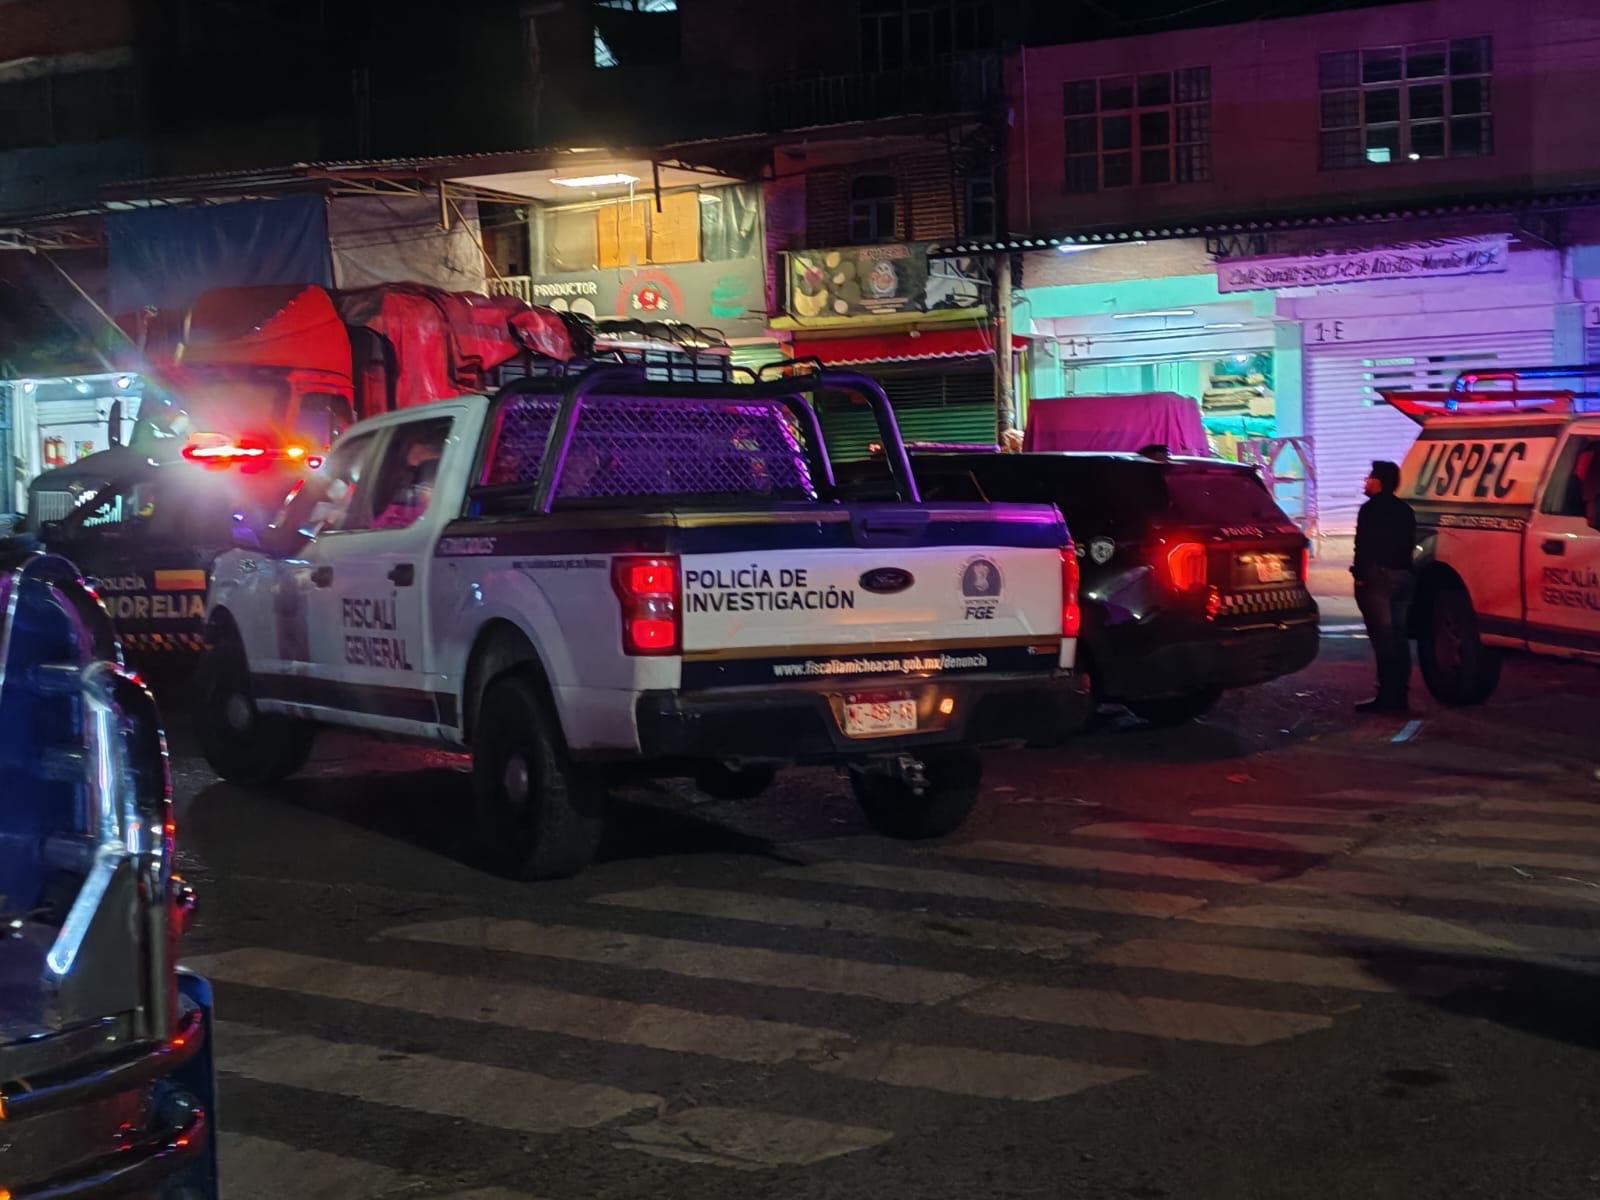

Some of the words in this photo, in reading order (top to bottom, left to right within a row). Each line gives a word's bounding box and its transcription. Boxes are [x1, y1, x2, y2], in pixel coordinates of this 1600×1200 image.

[533, 281, 598, 297] PRODUCTOR
[1414, 441, 1527, 498] USPEC
[685, 563, 773, 589] POLICÍA
[780, 569, 807, 588] DE
[686, 584, 855, 613] INVESTIGACIÓN
[964, 606, 996, 620] FGE
[345, 635, 413, 671] GENERAL
